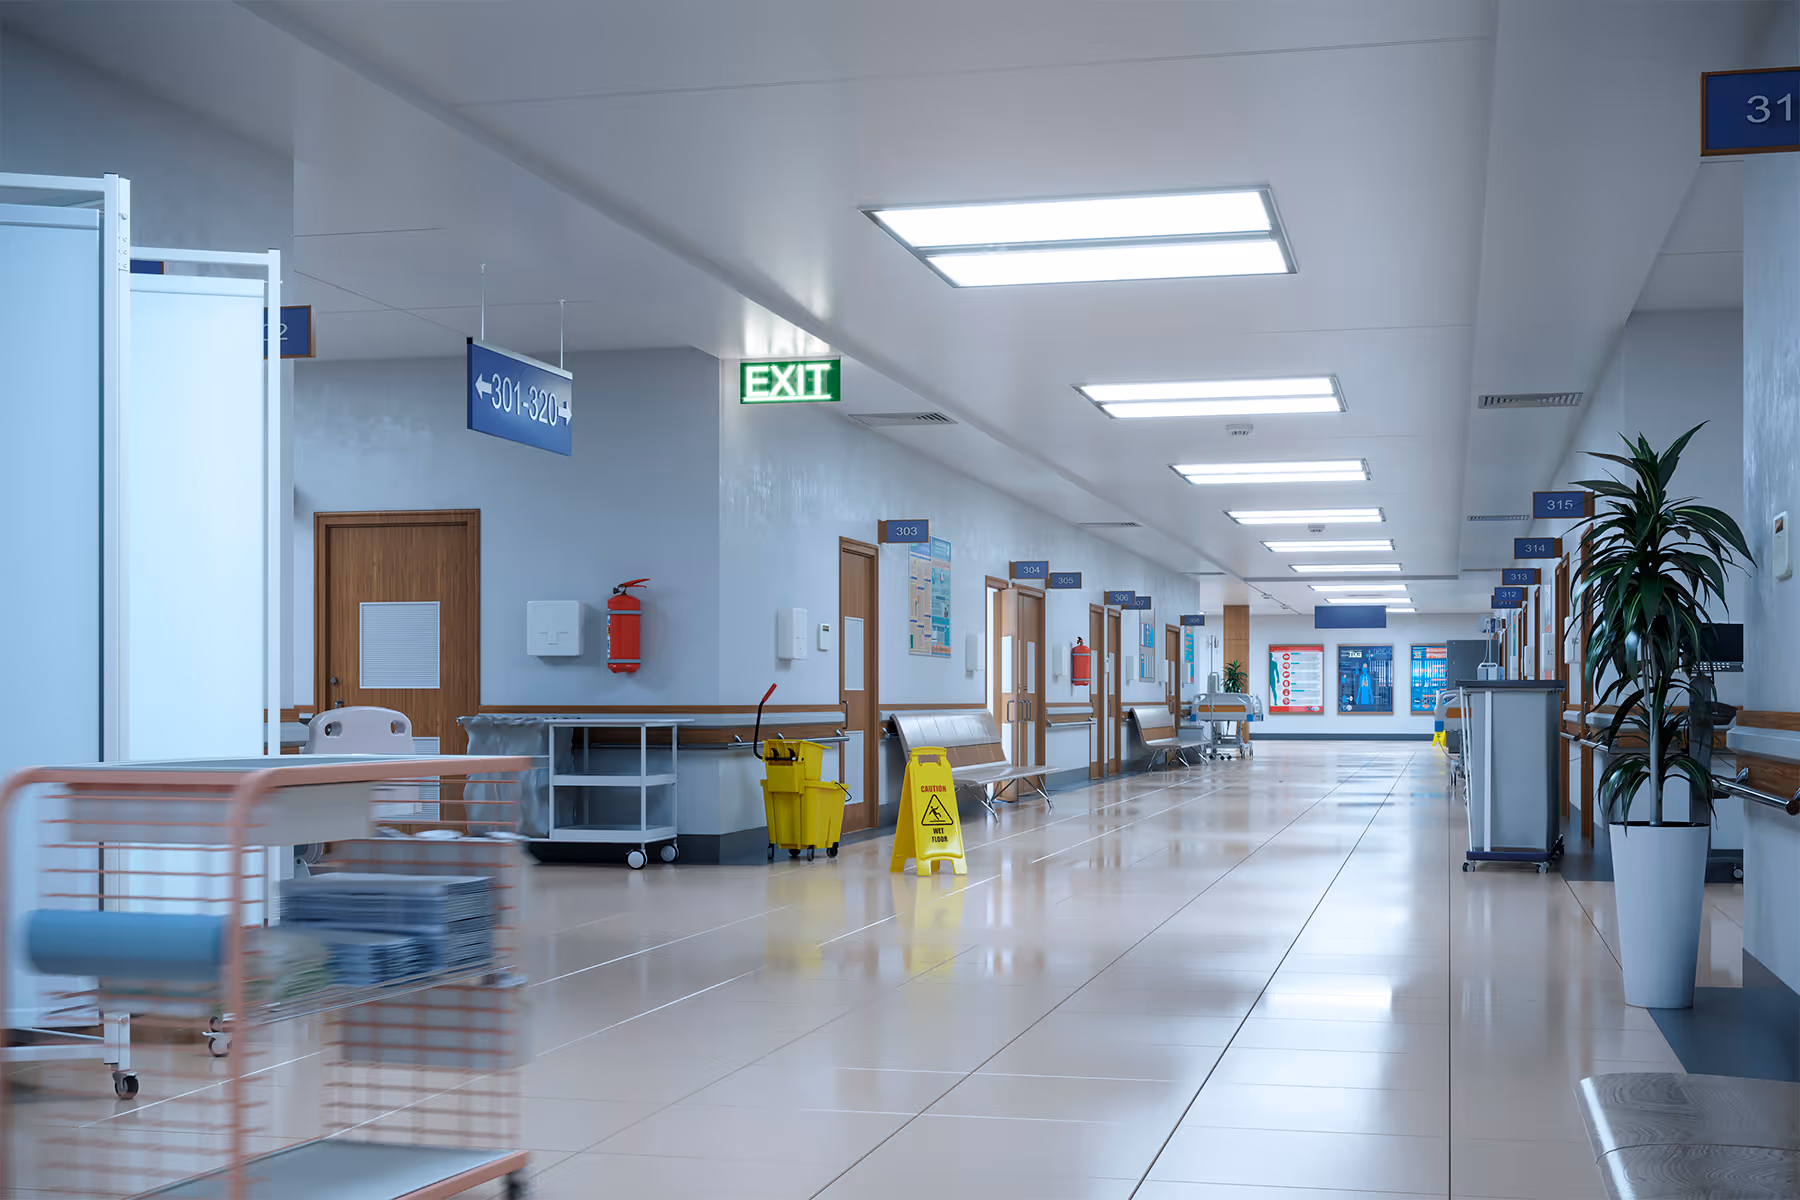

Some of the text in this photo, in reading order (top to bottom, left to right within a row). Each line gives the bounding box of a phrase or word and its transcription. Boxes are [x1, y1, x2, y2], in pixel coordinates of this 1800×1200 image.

[1746, 93, 1792, 124] 31
[744, 363, 832, 398] EXIT
[492, 373, 557, 427] 301-320
[1547, 500, 1573, 510] 315
[896, 527, 918, 536] 303
[1525, 544, 1545, 553] 314
[1024, 566, 1040, 575] 304
[1058, 576, 1073, 585] 305
[1511, 573, 1528, 581] 313
[1115, 594, 1129, 602] 306
[921, 785, 947, 793] CAUTION
